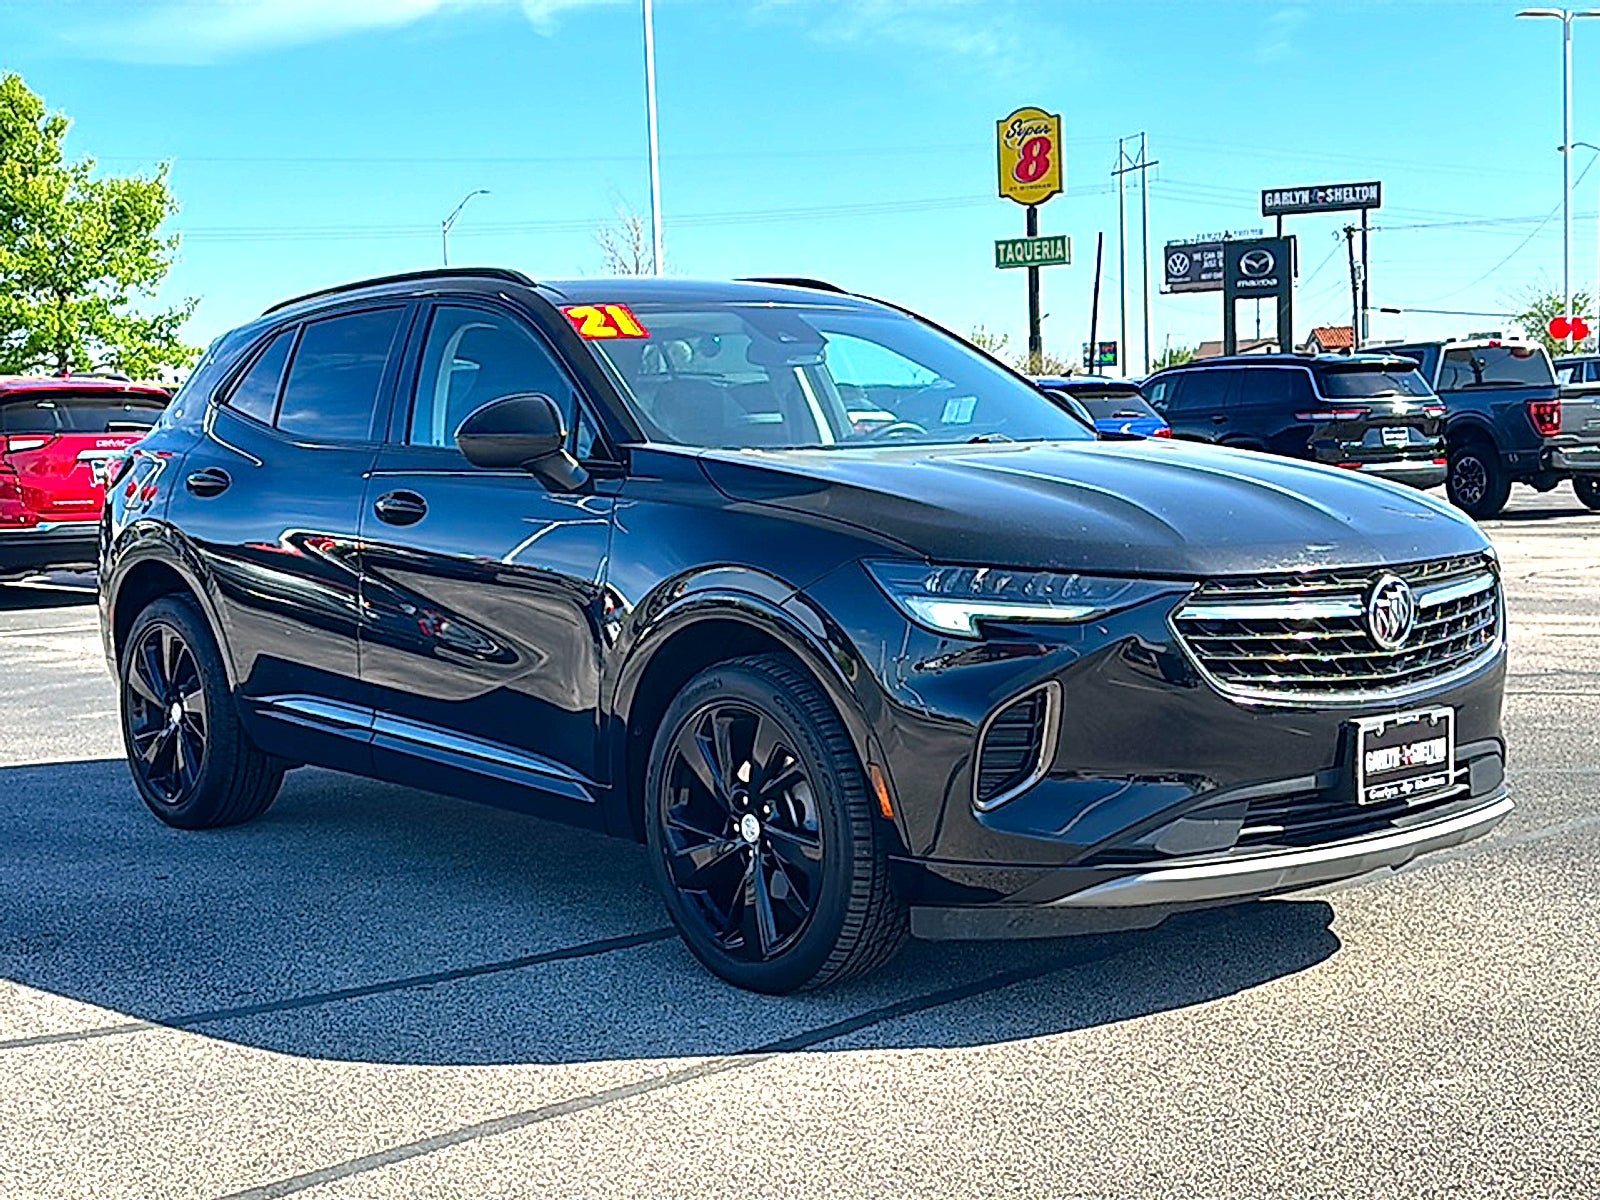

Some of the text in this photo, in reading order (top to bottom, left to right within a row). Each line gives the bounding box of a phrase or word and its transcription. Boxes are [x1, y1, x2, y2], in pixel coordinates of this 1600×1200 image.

[1006, 118, 1052, 146] Super
[1013, 137, 1051, 184] 8
[1326, 185, 1378, 203] SHELTON
[998, 239, 1065, 263] TAQUERIA
[567, 306, 644, 337] 21
